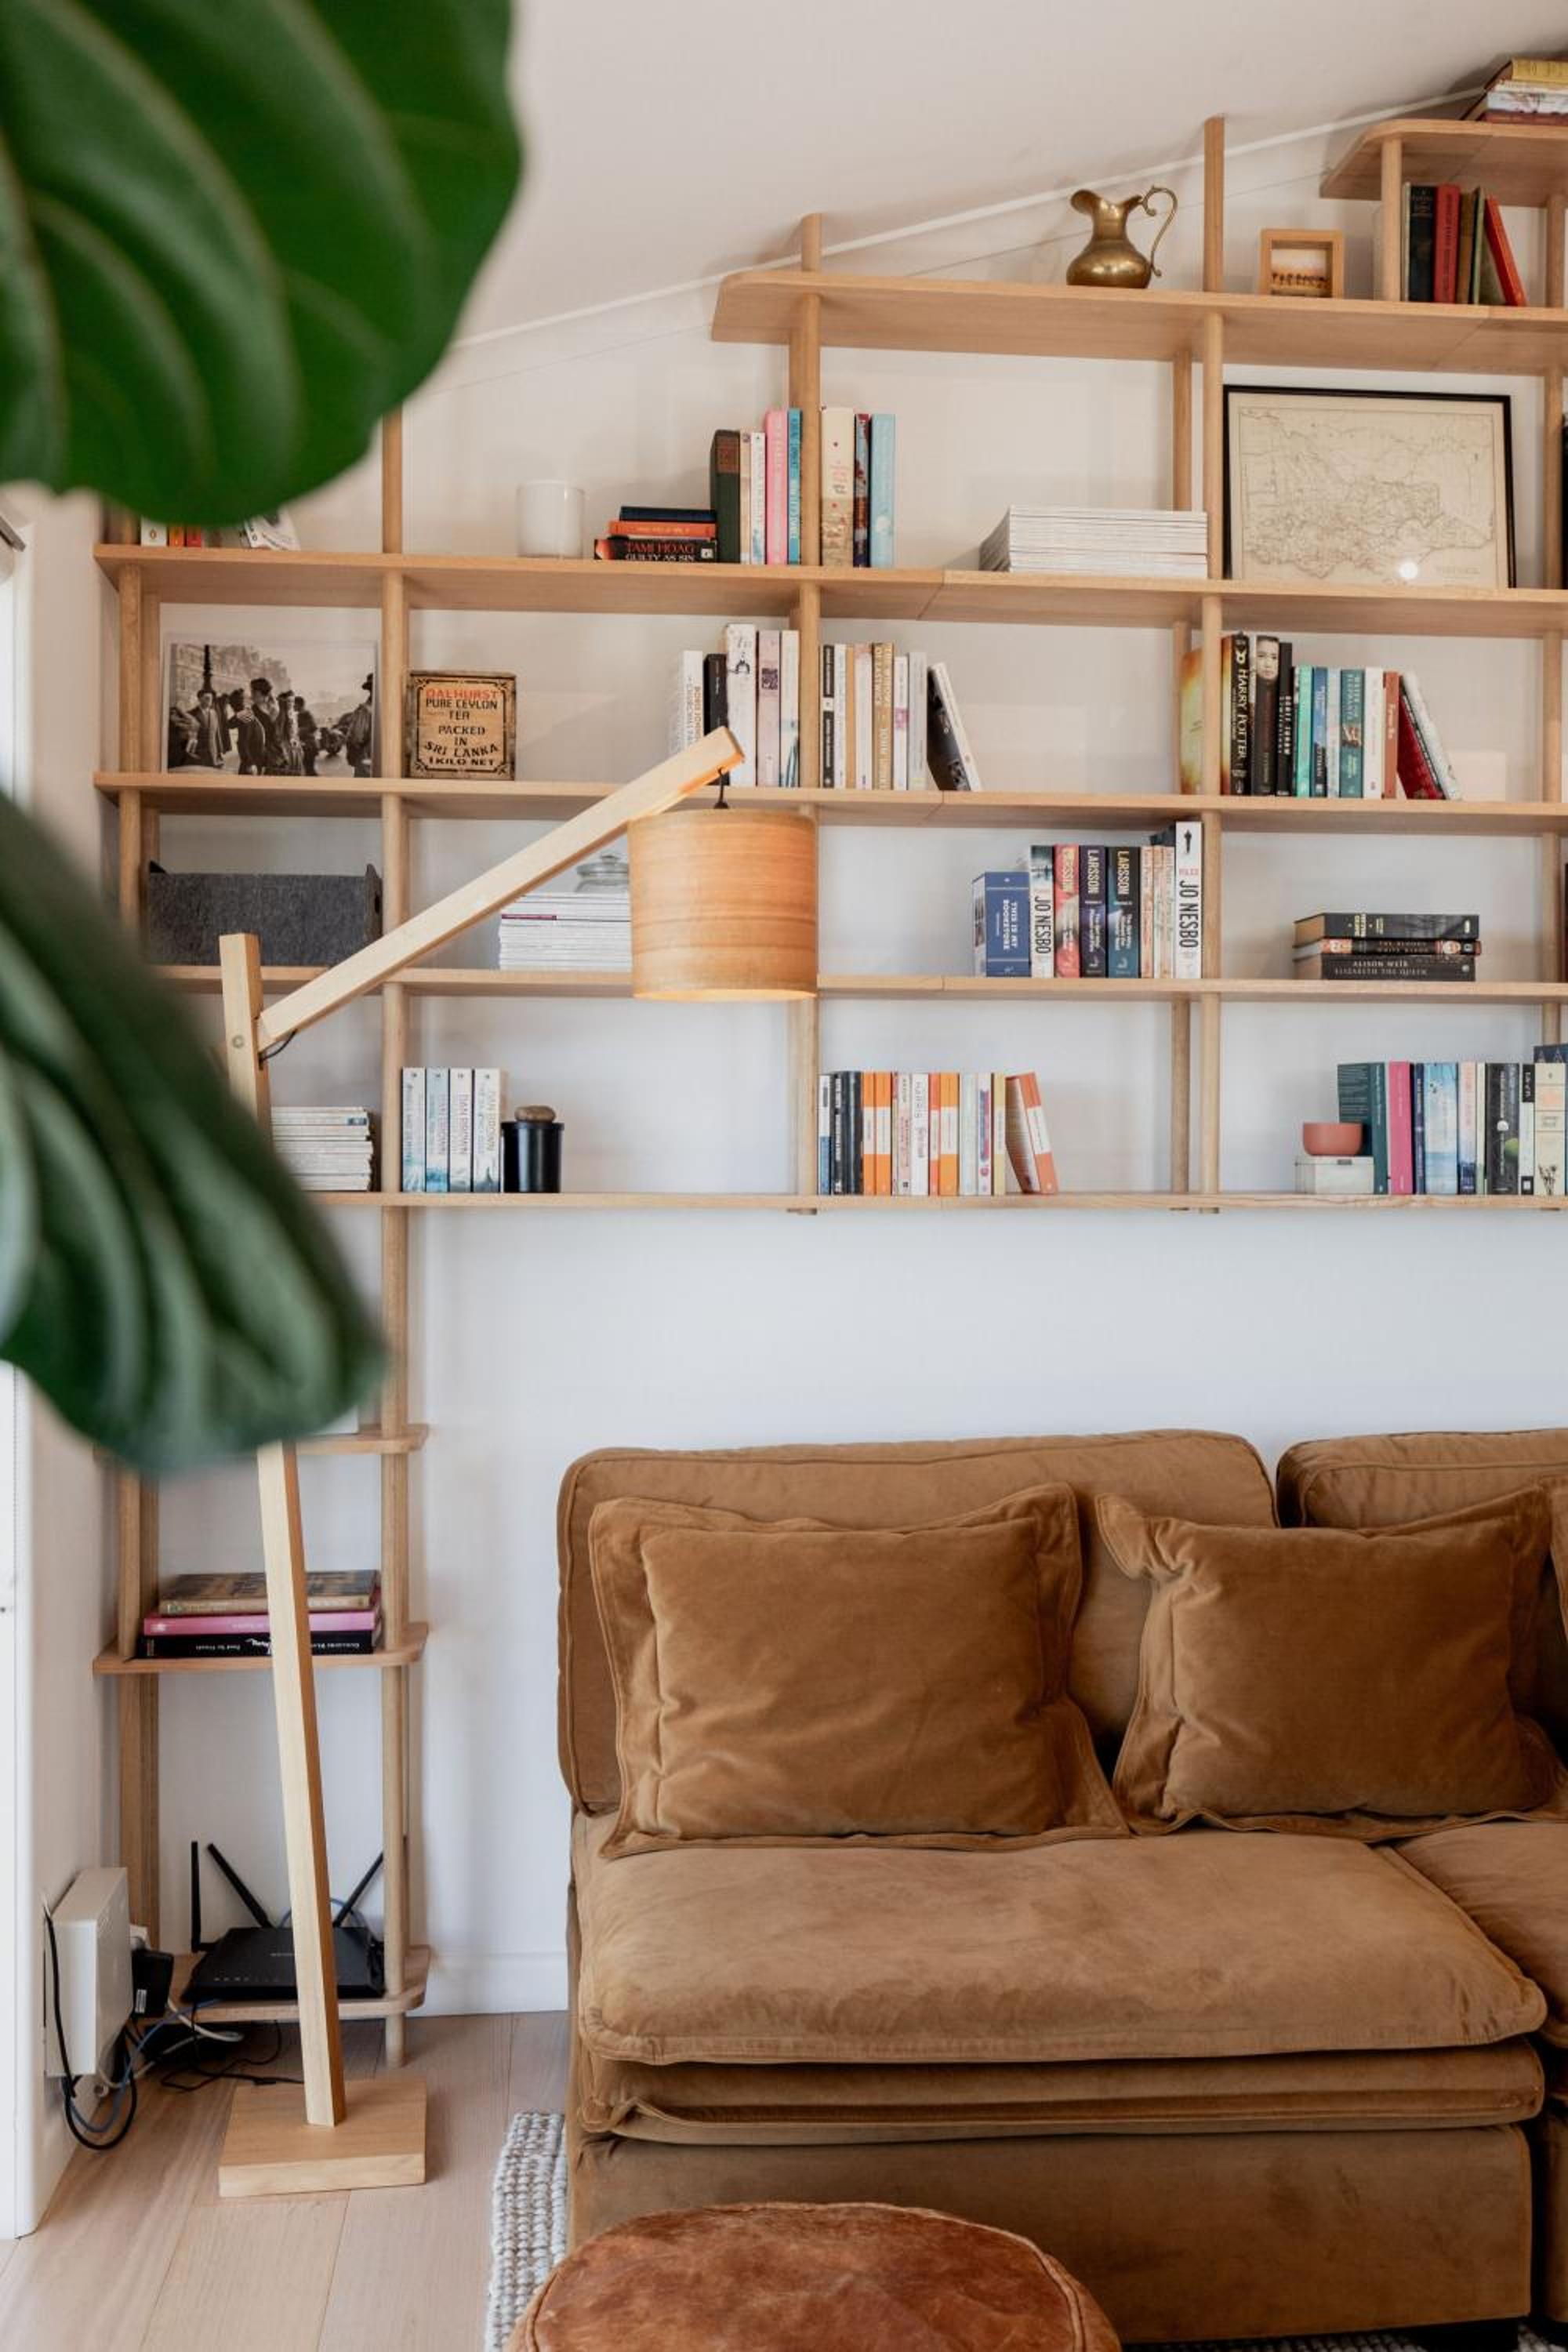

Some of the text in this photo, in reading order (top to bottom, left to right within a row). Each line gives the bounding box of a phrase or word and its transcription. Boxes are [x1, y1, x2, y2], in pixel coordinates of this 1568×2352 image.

[426, 689, 498, 699] DALHURST
[426, 699, 498, 710] PURE CEYLON
[1236, 669, 1249, 758] HARRY POTTER
[438, 725, 485, 735] PACKED
[424, 741, 499, 758] SRI LANKA
[454, 737, 468, 746] IN
[1087, 849, 1100, 894] LARSSON
[1117, 851, 1130, 895] LARSSON
[1179, 880, 1200, 948] JO NESBO
[1011, 924, 1018, 933] IS
[1034, 895, 1051, 954] JO NESBO
